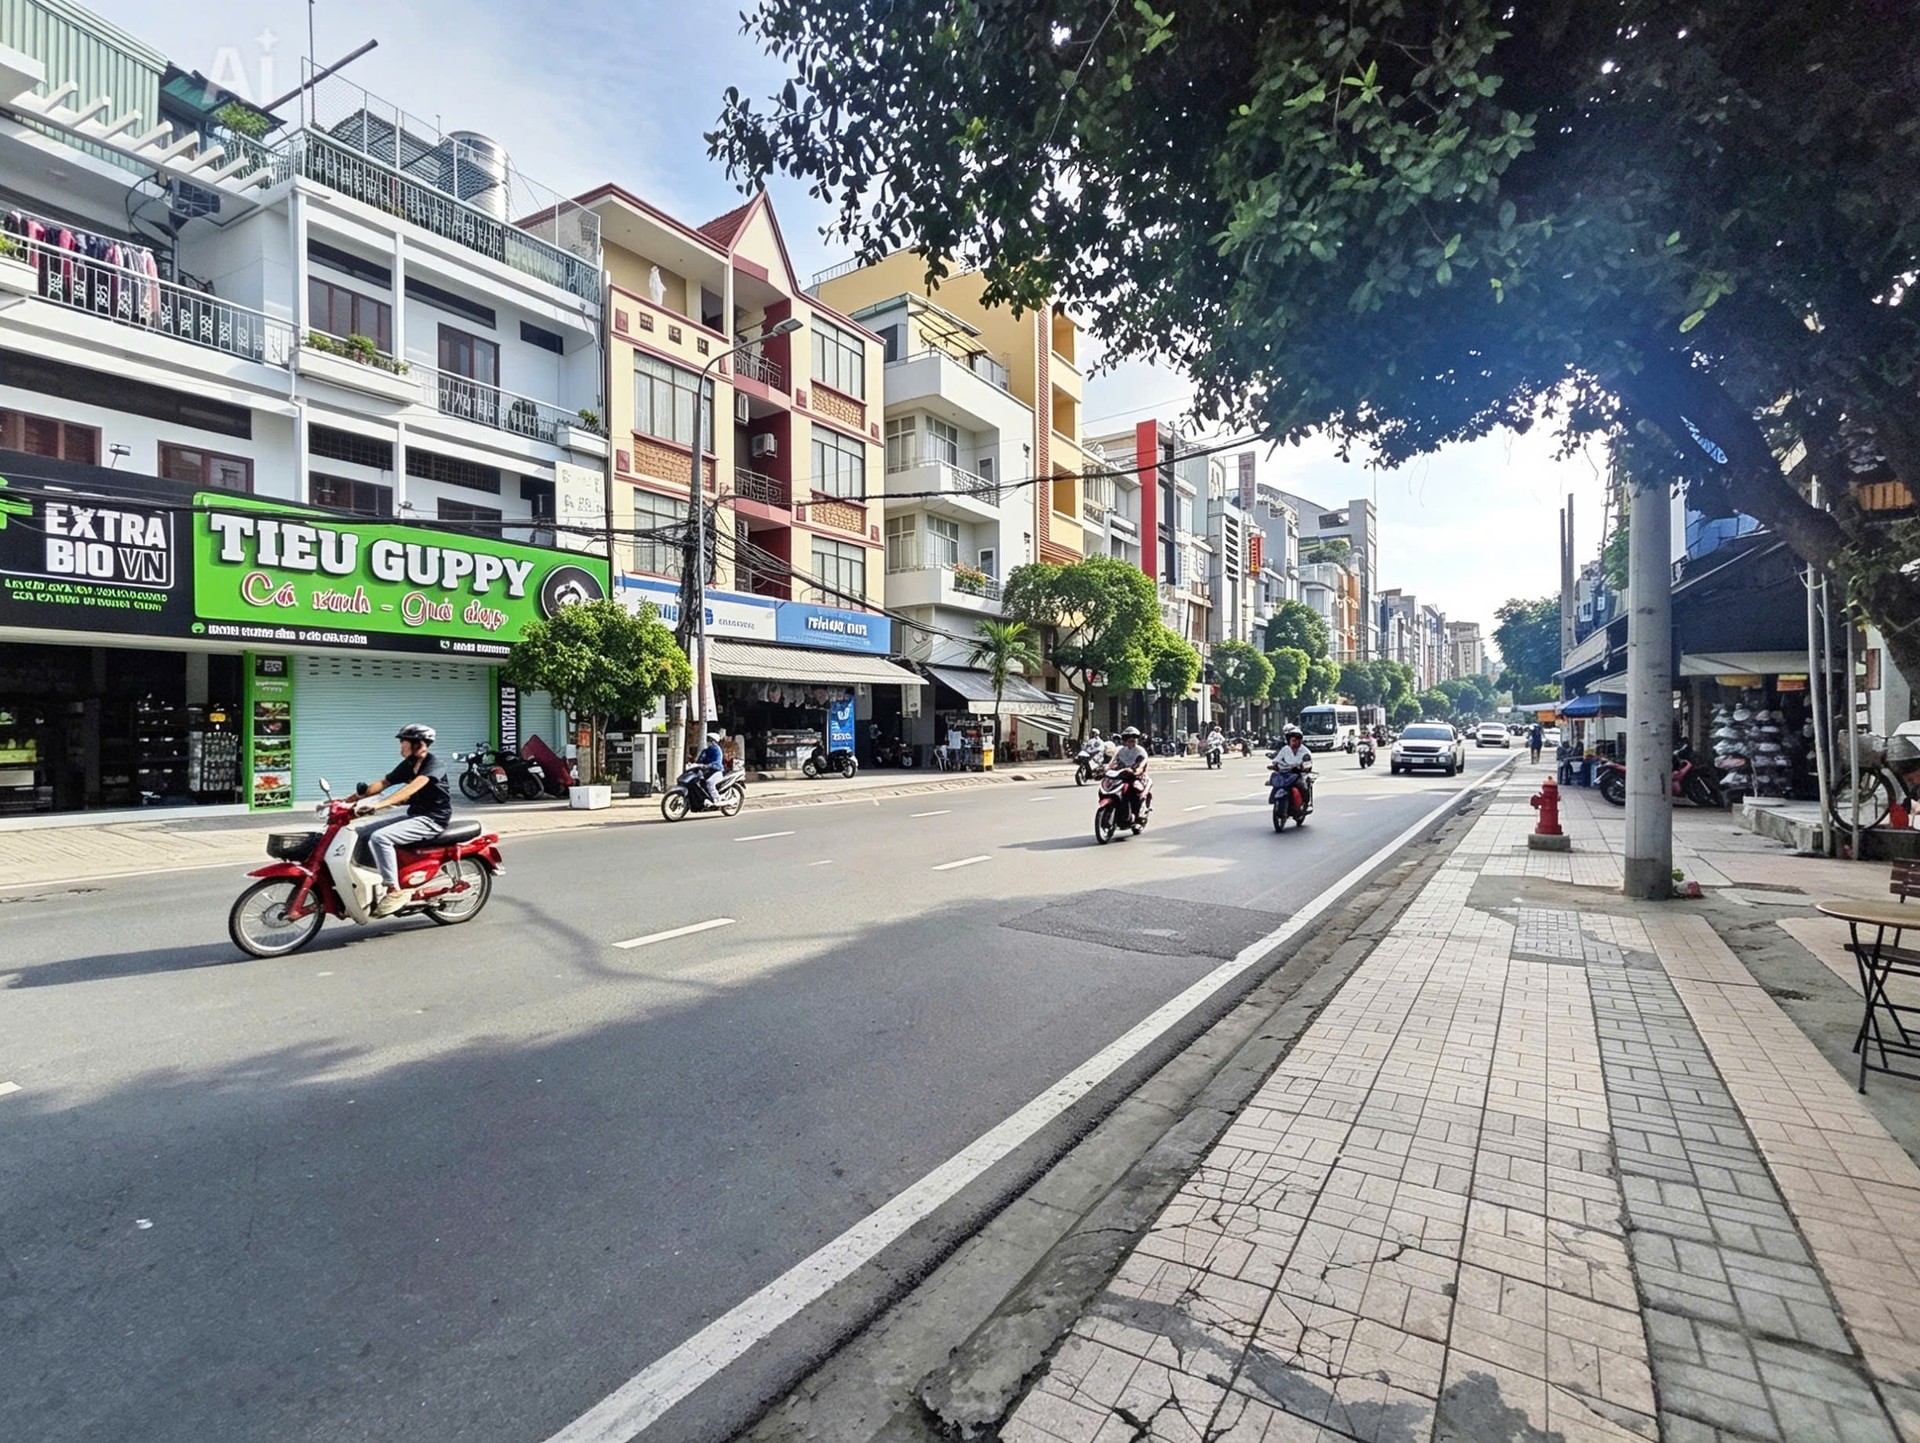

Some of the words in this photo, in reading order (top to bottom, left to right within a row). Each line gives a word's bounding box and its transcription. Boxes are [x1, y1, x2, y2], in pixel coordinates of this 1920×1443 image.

[45, 502, 167, 549] EXTRA
[211, 513, 359, 575] TIEU
[371, 538, 535, 598] GUPPY
